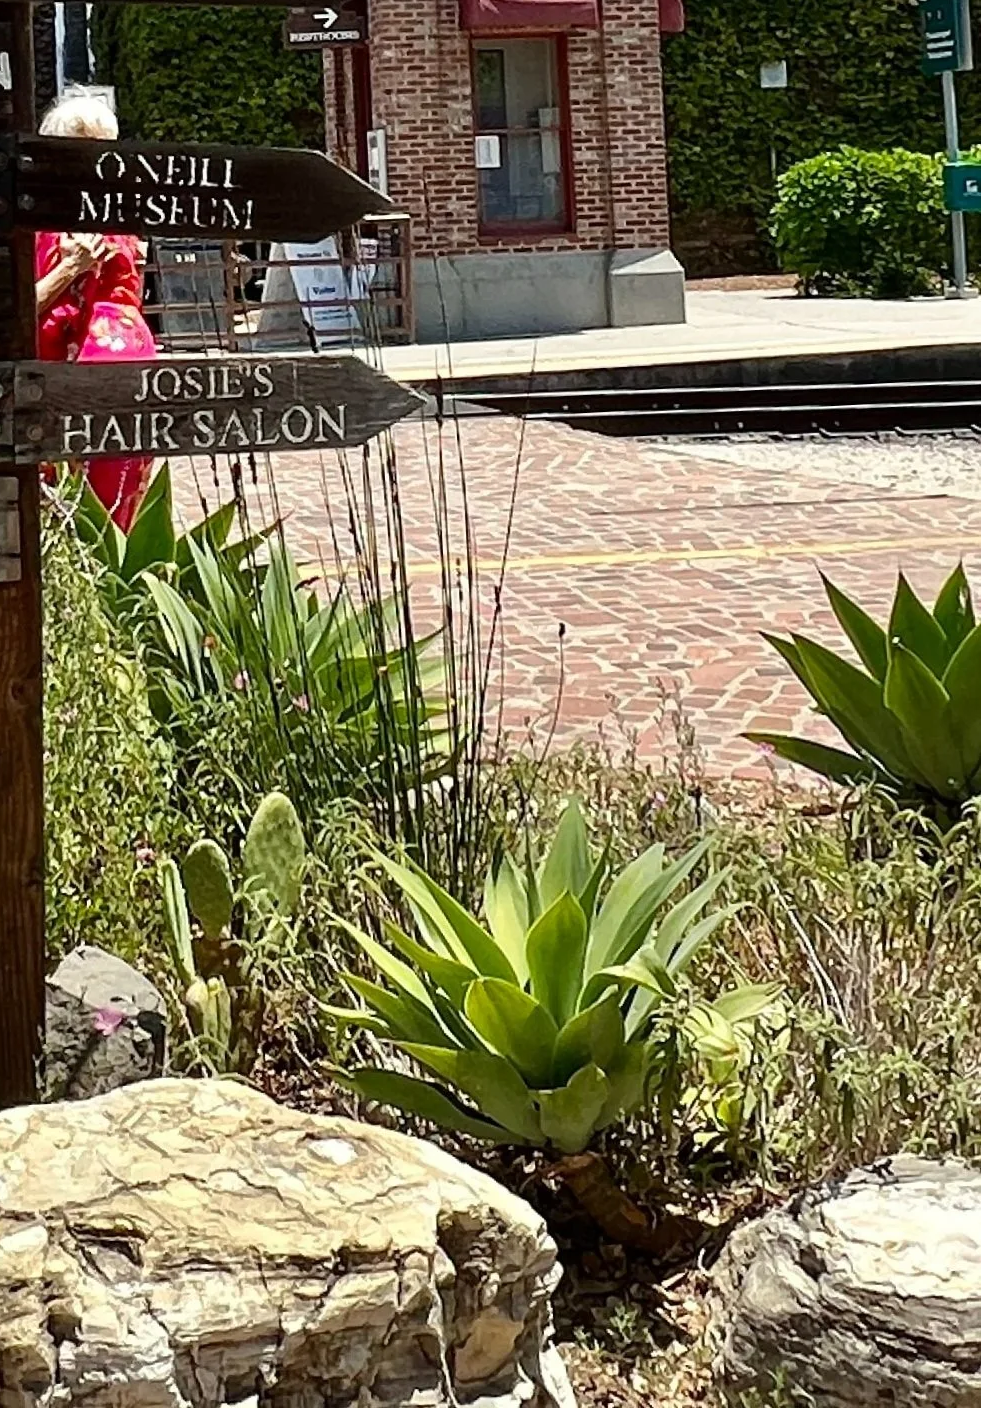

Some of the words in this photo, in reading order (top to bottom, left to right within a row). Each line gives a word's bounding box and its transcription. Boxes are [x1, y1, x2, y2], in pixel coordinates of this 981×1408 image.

[78, 191, 253, 230] MUSEUM
[134, 363, 274, 402] JOSIE'S
[61, 411, 181, 455] HAIR
[193, 403, 347, 449] SALON
